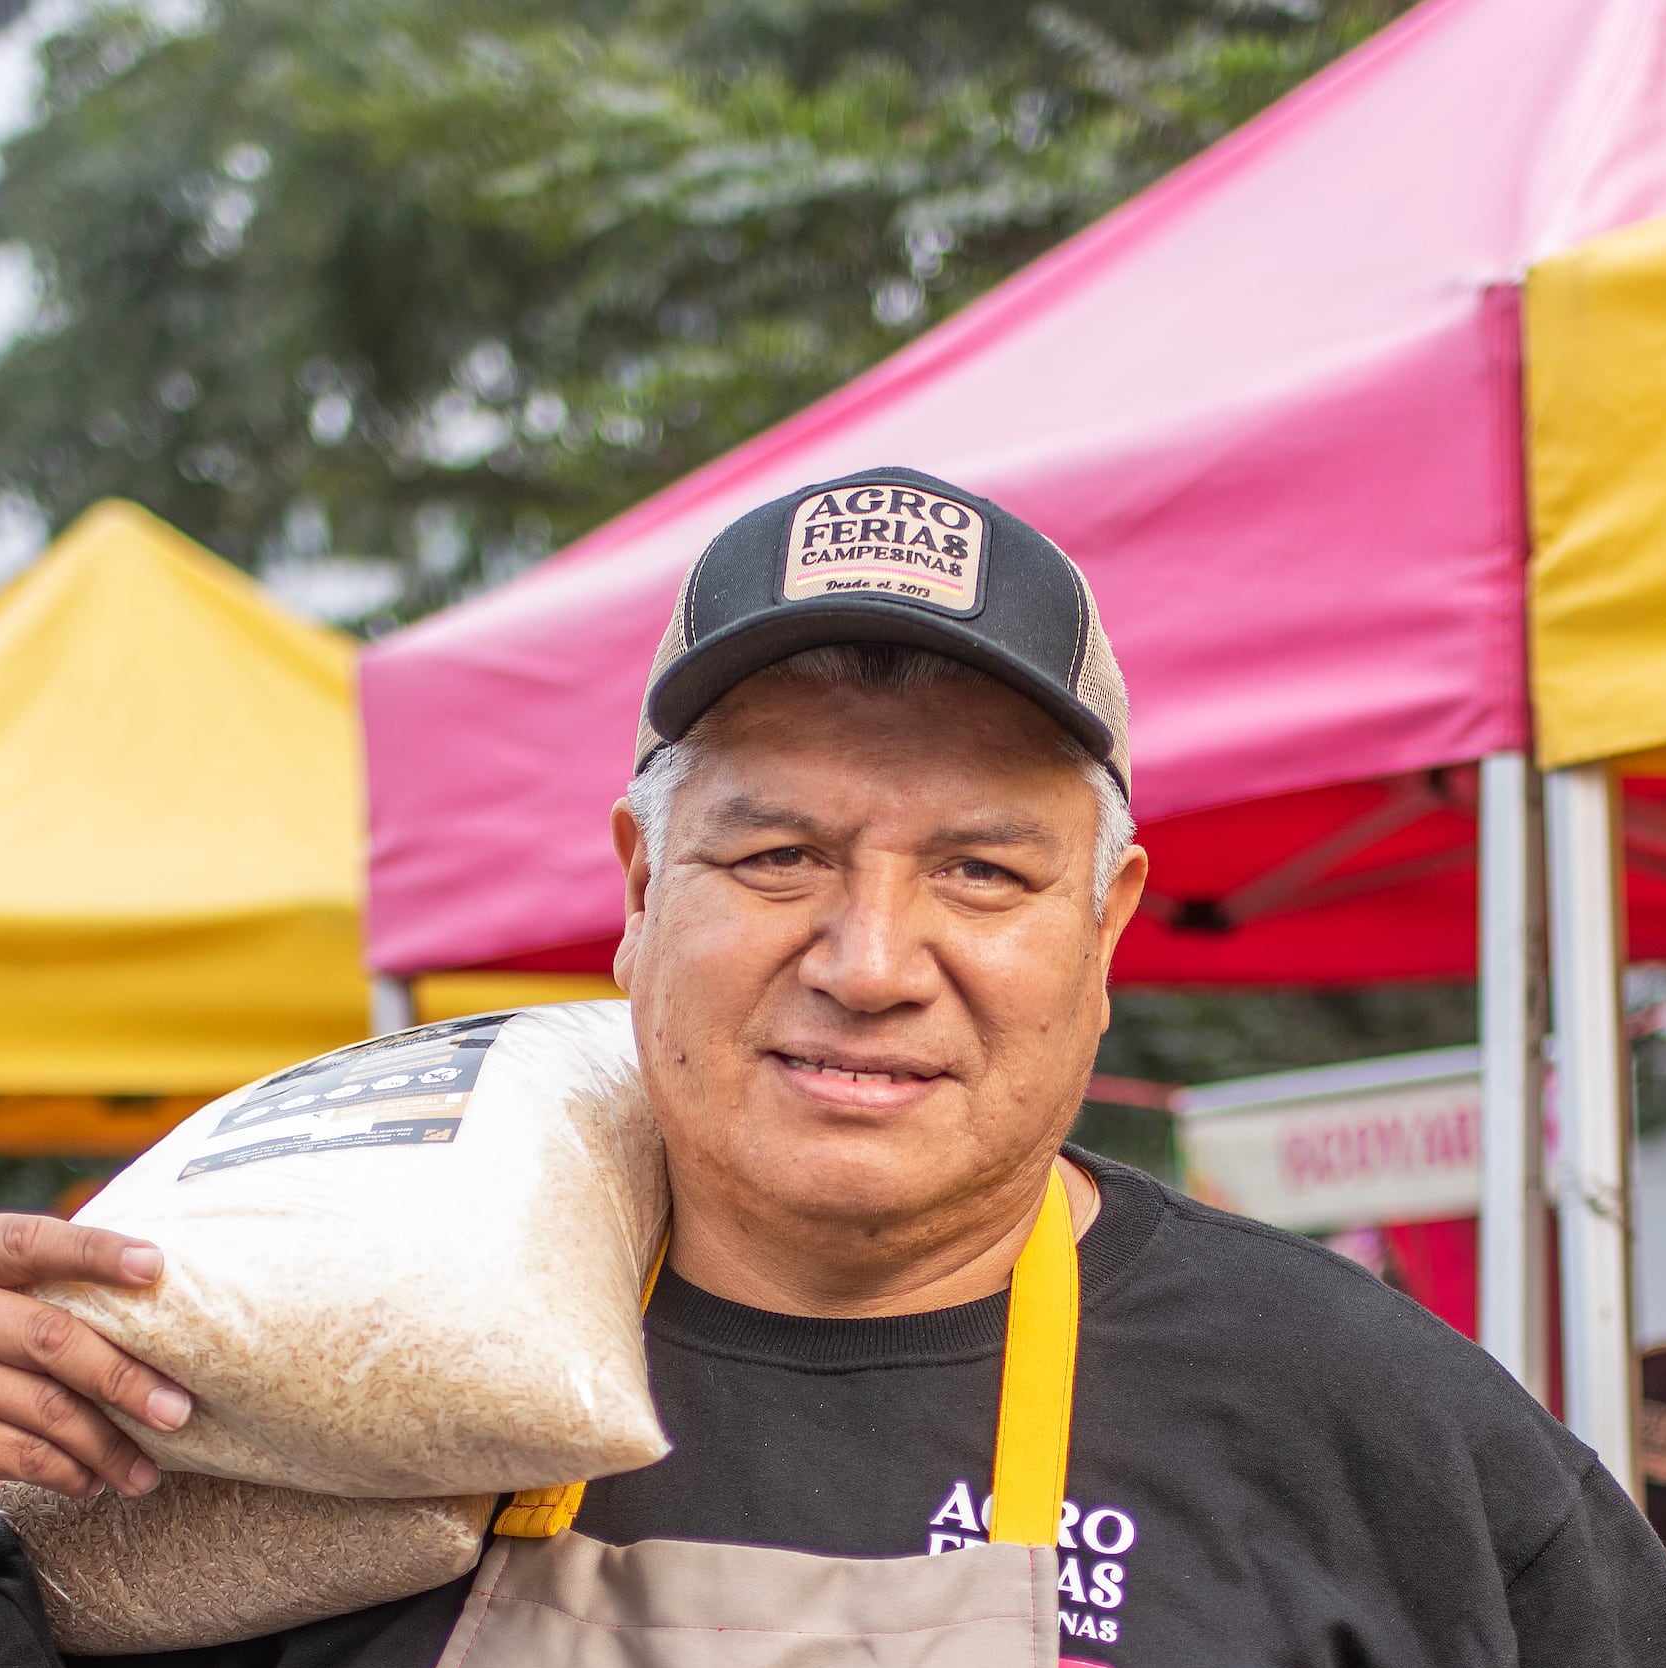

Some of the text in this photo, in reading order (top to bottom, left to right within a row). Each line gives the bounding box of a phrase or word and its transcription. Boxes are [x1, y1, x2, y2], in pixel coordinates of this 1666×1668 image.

[806, 488, 971, 531] AGRO
[801, 518, 969, 560] FERIAS
[800, 545, 963, 578] CAMPESINAS
[825, 579, 871, 591] Desde
[897, 583, 931, 598] 2013
